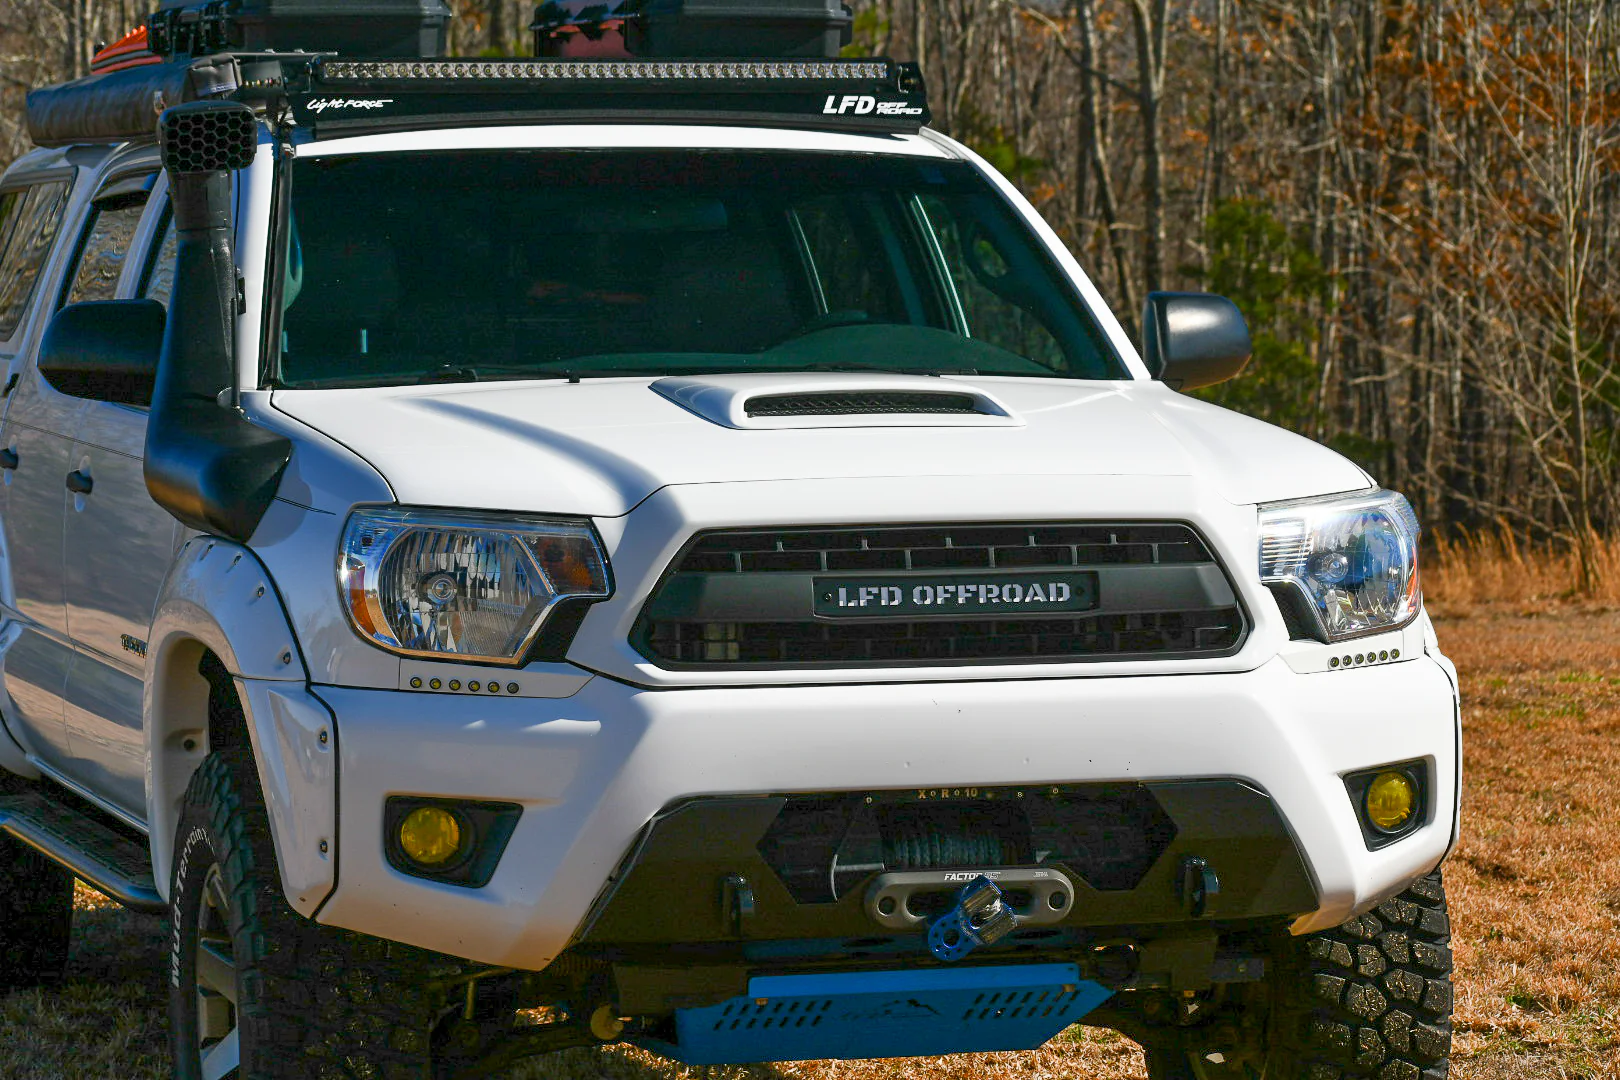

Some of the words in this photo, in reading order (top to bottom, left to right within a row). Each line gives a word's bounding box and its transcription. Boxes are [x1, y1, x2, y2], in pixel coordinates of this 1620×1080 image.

[822, 95, 876, 114] LFD
[838, 586, 902, 607] LFD
[912, 582, 1071, 605] OFFROAD
